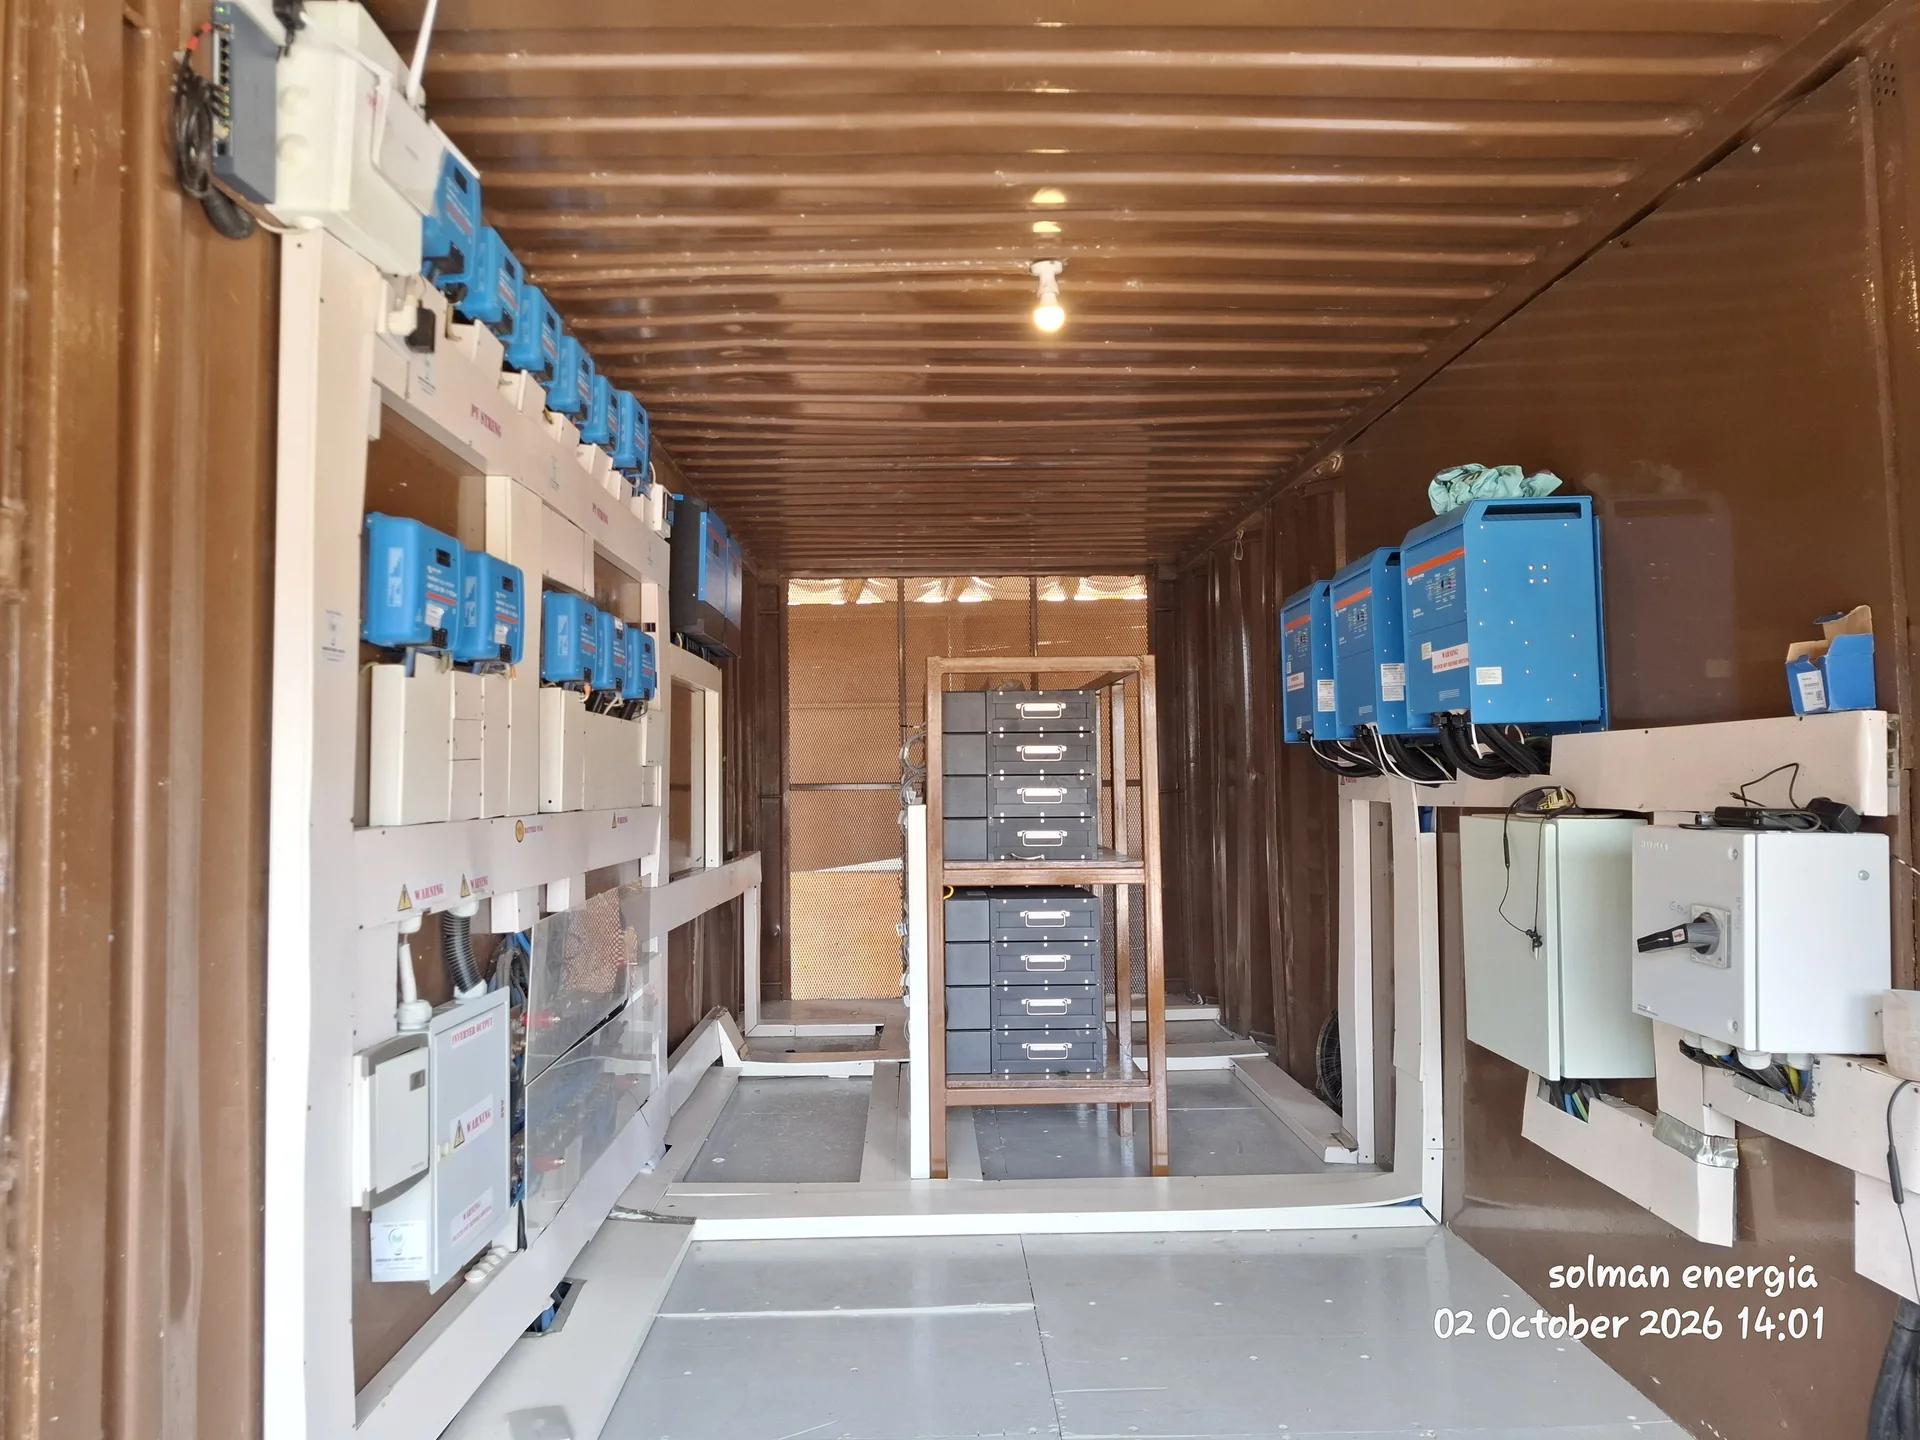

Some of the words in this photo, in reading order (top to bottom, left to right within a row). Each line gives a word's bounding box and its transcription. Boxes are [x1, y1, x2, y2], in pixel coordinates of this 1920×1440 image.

[414, 883, 444, 900] WARNING
[470, 876, 489, 889] WARNING
[451, 1026, 475, 1044] INVERTER
[476, 1017, 493, 1033] OUTPUT
[466, 1108, 491, 1132] WARNING
